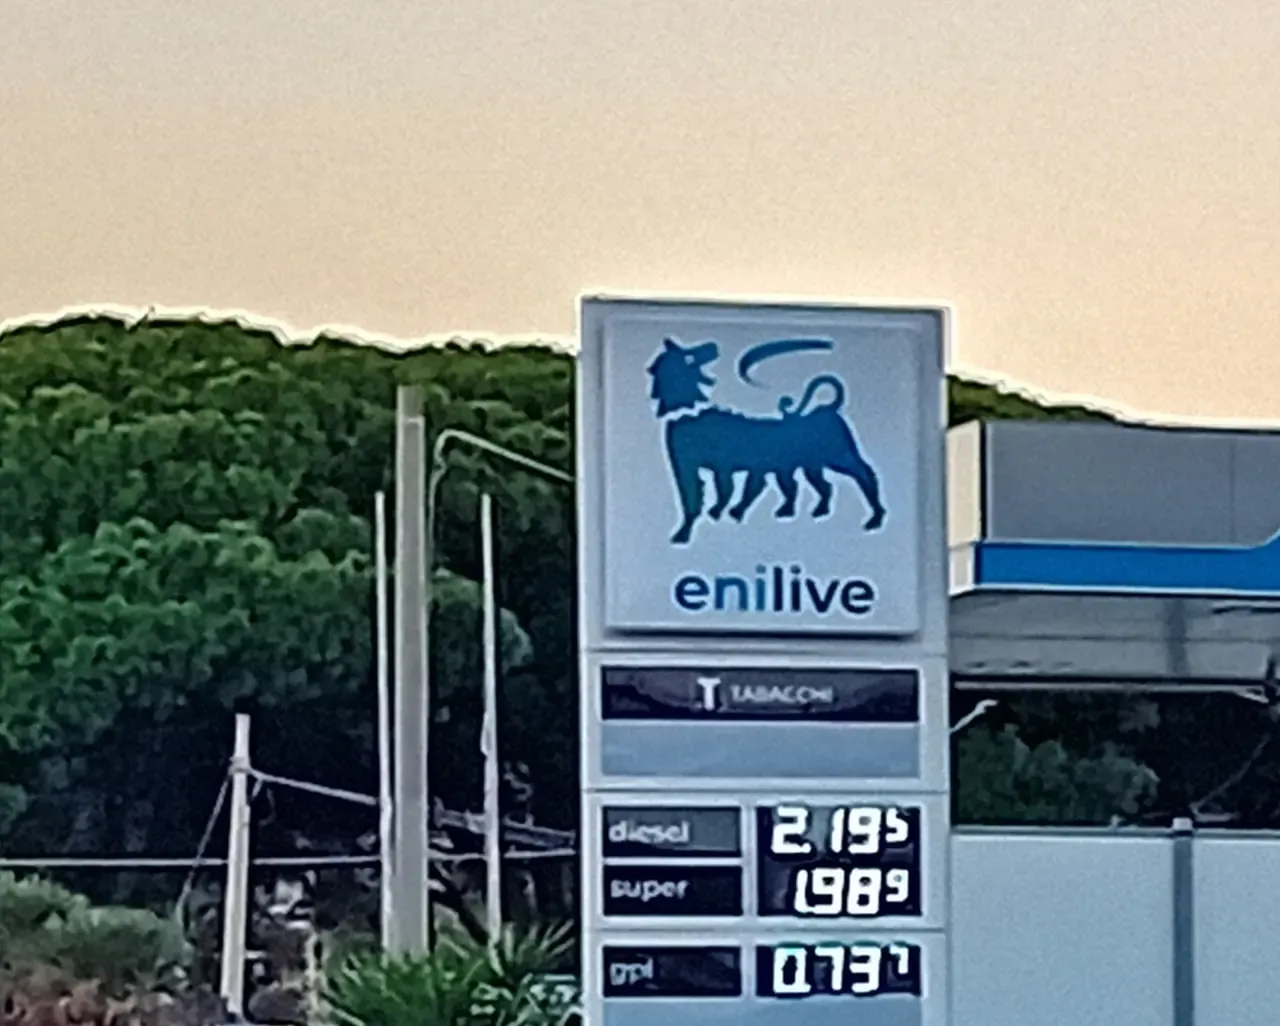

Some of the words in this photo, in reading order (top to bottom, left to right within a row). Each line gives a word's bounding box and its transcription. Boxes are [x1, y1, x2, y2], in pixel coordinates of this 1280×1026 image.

[674, 564, 876, 615] enilive
[608, 819, 690, 844] diesel
[610, 879, 690, 902] super
[609, 956, 654, 986] gpl
